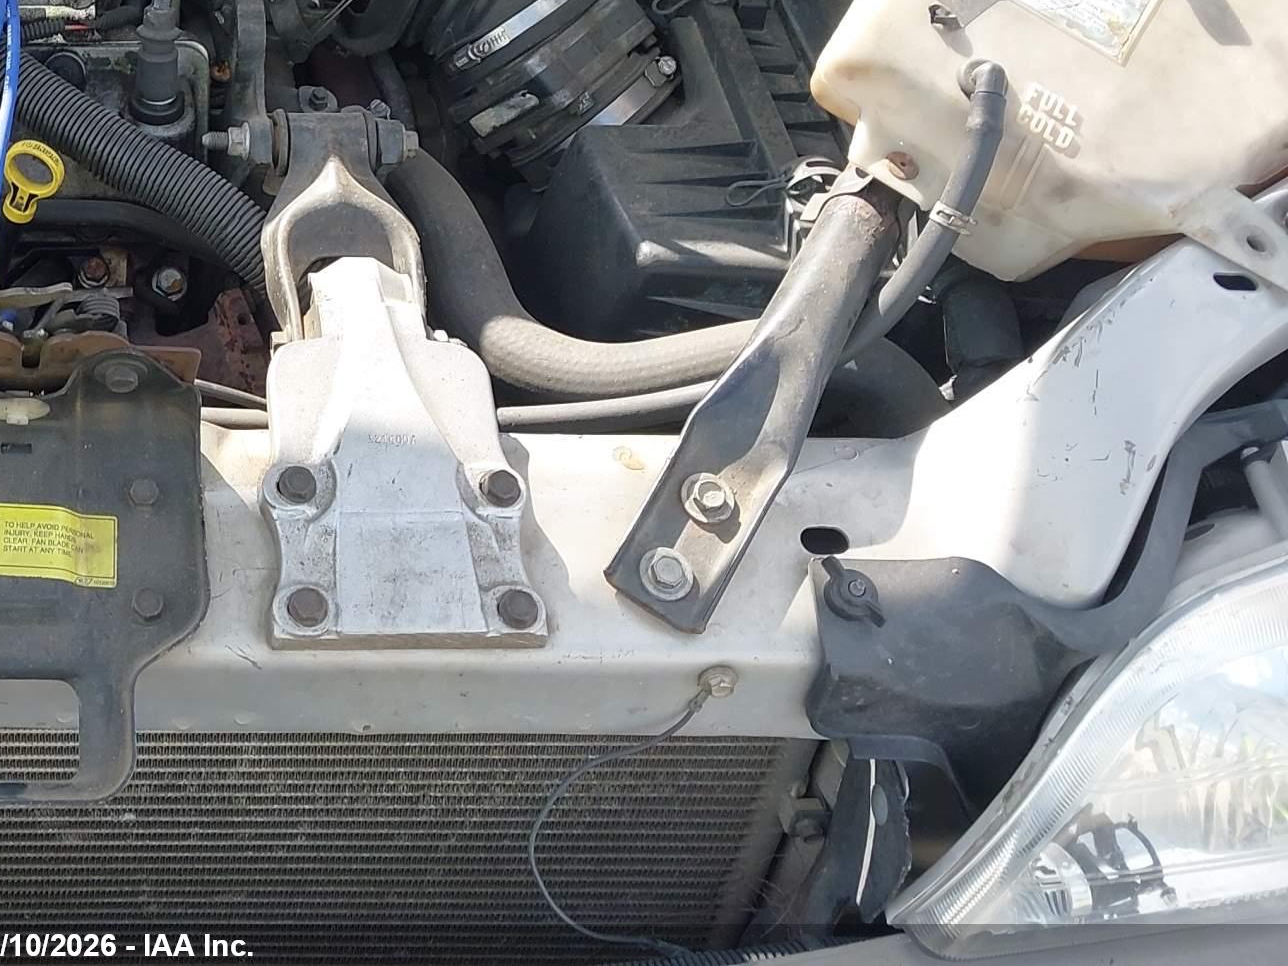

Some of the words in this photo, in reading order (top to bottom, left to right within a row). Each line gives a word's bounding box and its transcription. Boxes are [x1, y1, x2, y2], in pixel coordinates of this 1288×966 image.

[1024, 81, 1077, 127] FULL
[1016, 104, 1075, 149] COLD
[5, 521, 14, 529] TO
[37, 523, 59, 531] AVOID
[33, 530, 53, 538] KEEP
[31, 538, 46, 546] FAN
[47, 539, 70, 549] BLADE
[3, 544, 26, 553] START
[28, 545, 37, 553] AT
[40, 545, 55, 554] ANY
